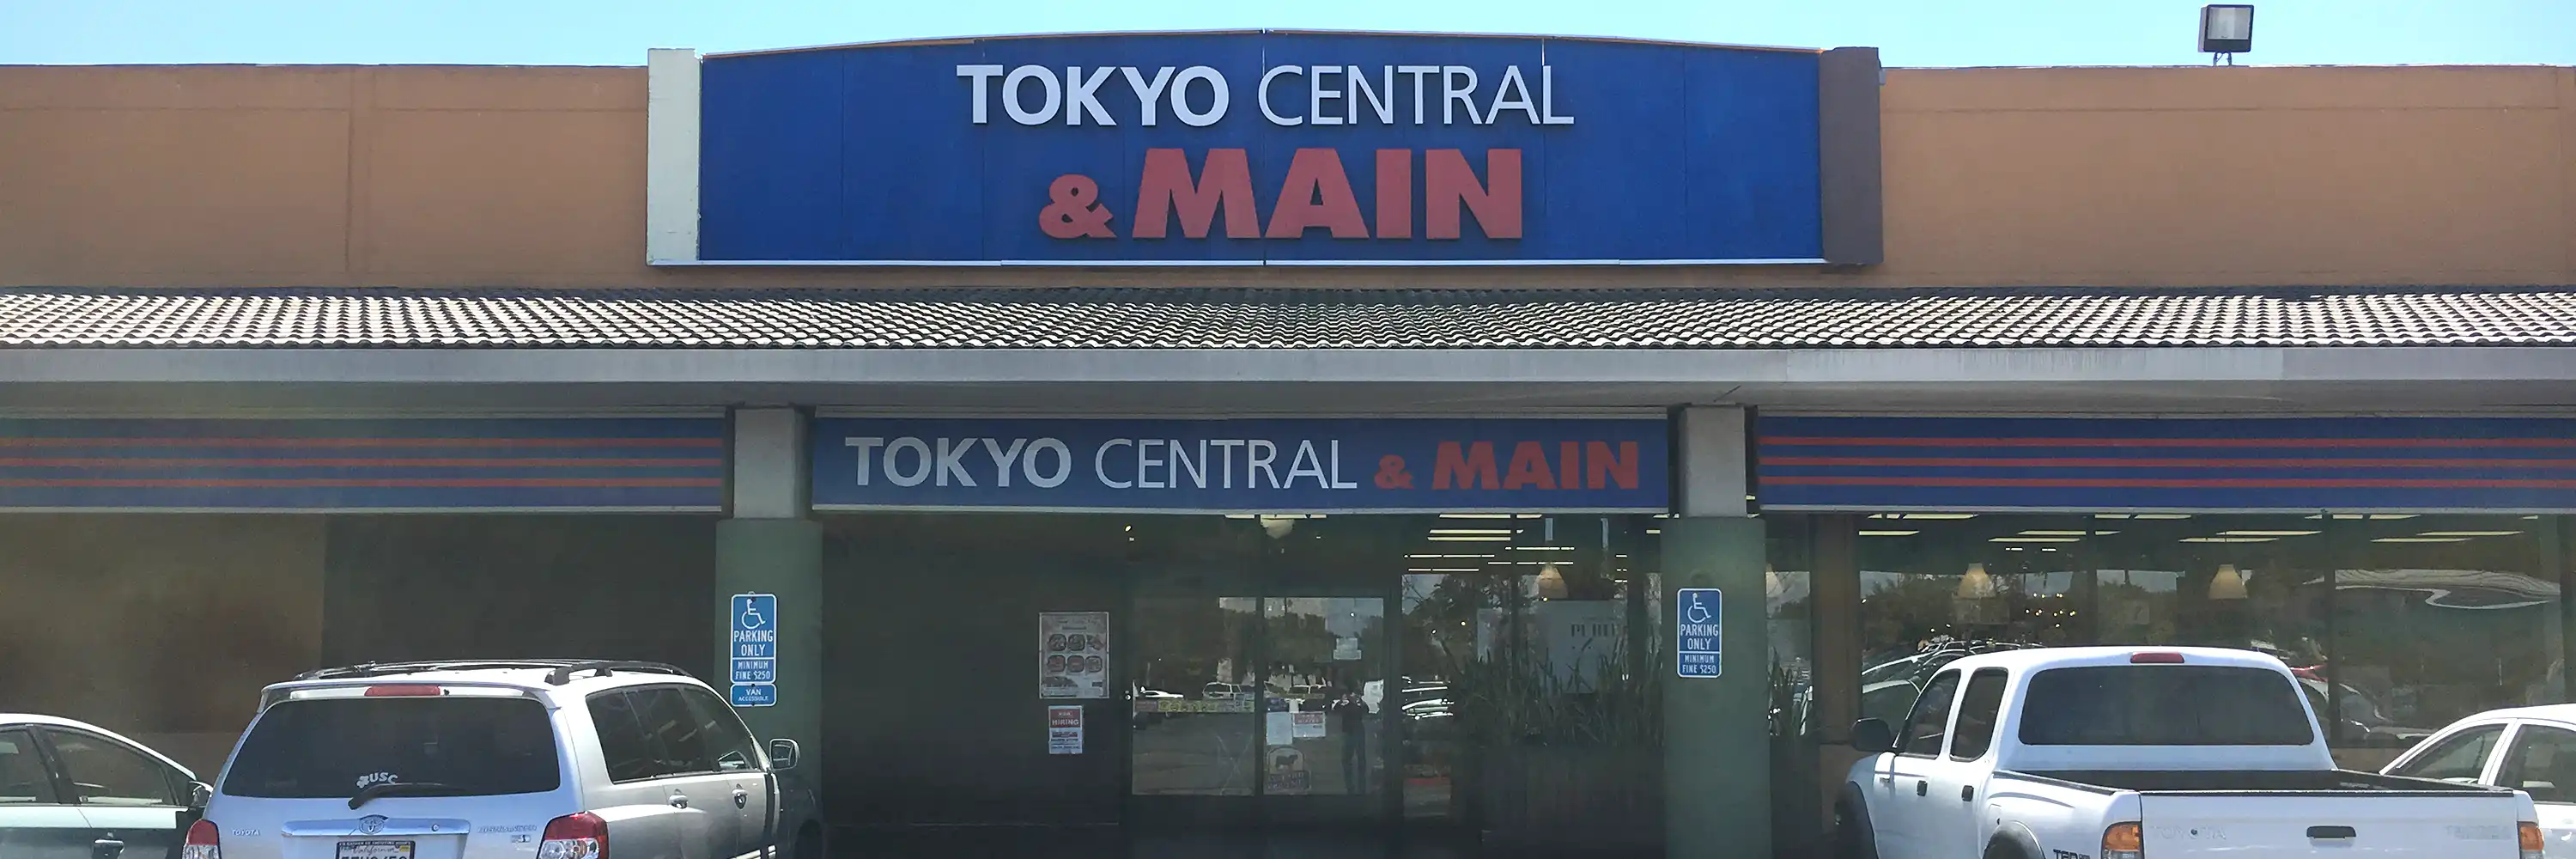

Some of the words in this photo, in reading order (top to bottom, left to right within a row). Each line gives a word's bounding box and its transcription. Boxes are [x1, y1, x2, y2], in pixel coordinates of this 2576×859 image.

[957, 64, 1230, 126] TOKYO
[1257, 64, 1575, 126] CENTRAL
[1038, 174, 1117, 239] &
[1132, 148, 1522, 240] MAIN
[845, 436, 1072, 489] TOKYO
[1094, 438, 1358, 490] CENTRAL
[1374, 454, 1415, 490] &
[1431, 440, 1639, 490] MAIN
[733, 630, 774, 643] PARKING
[1680, 624, 1719, 637] PARKING
[740, 643, 766, 656] ONLY
[1686, 637, 1712, 650] ONLY
[738, 661, 769, 669] MINIMUM
[1684, 654, 1715, 663] MINIMUM
[735, 671, 751, 680] FINE
[753, 671, 771, 680] $250
[1682, 664, 1698, 673] FINE
[1699, 664, 1717, 674] $250
[369, 771, 398, 785] USC
